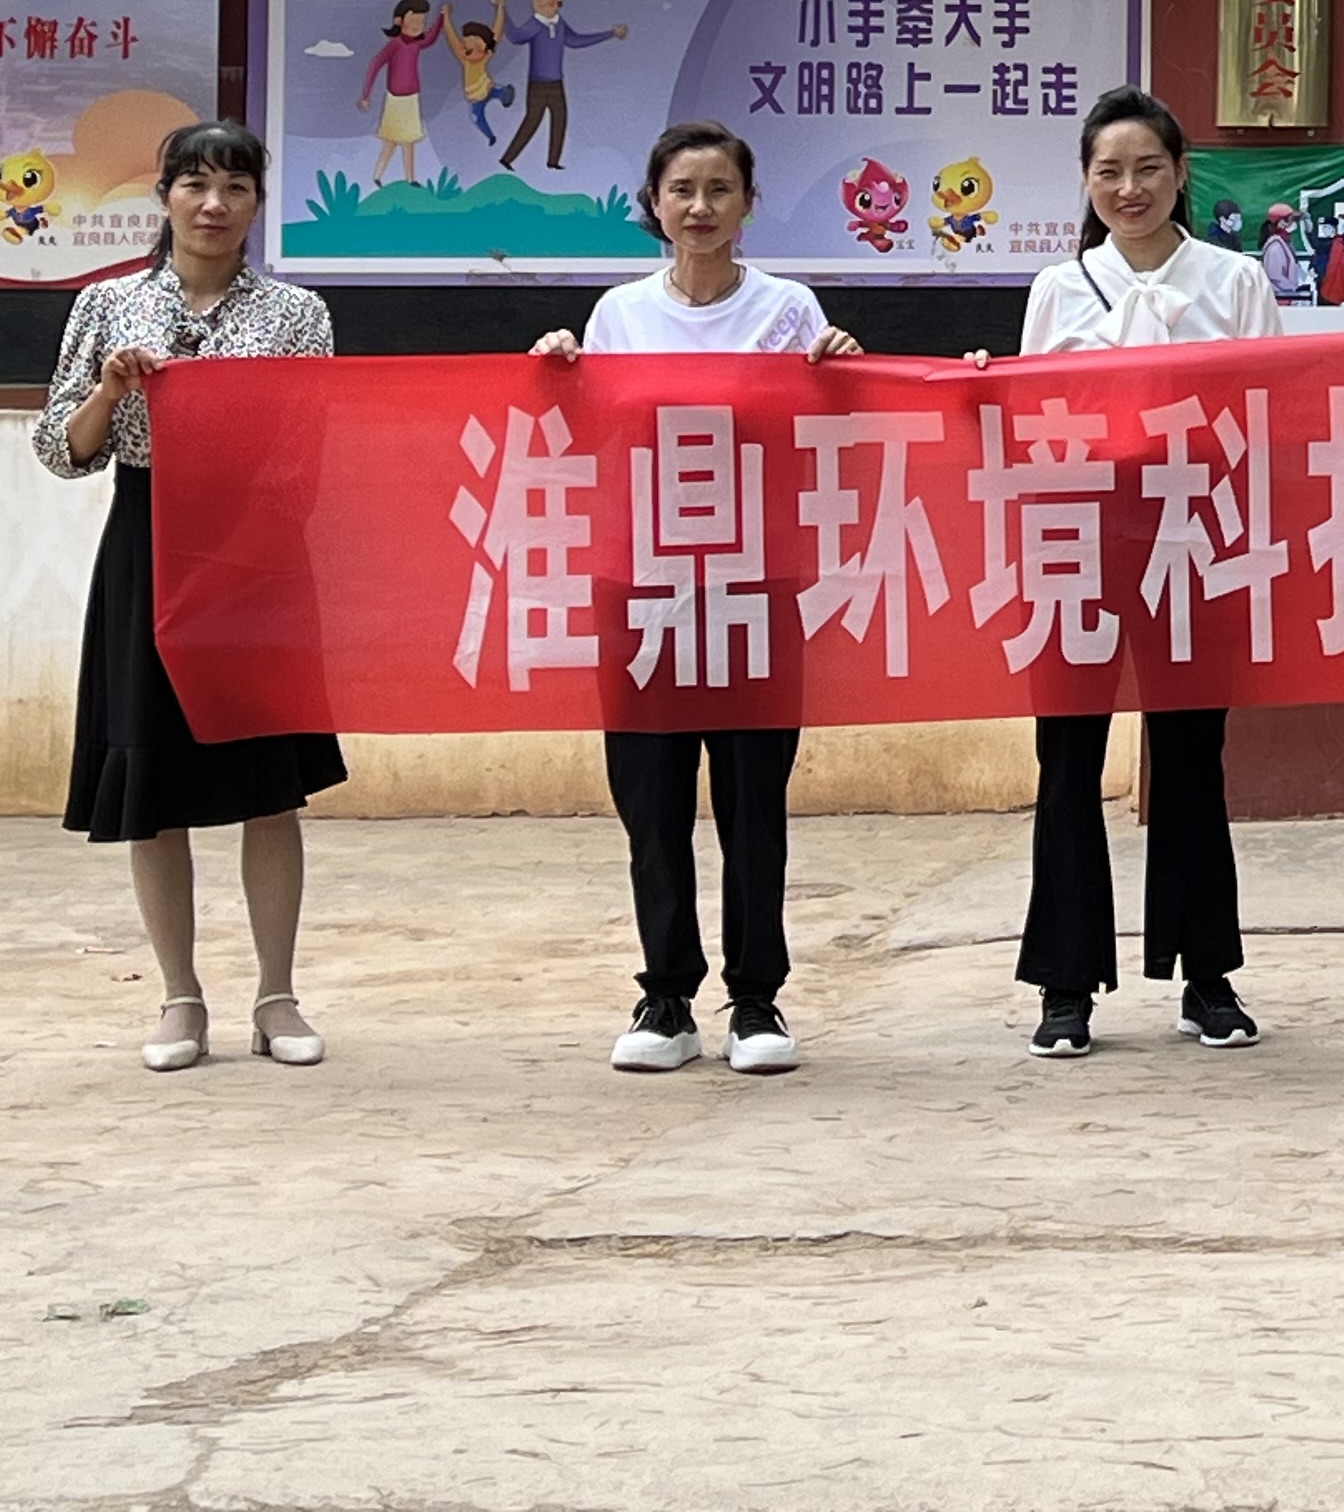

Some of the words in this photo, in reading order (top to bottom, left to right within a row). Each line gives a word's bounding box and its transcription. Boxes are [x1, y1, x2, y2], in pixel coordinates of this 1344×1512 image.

[749, 61, 1079, 116] 文明路上一起走
